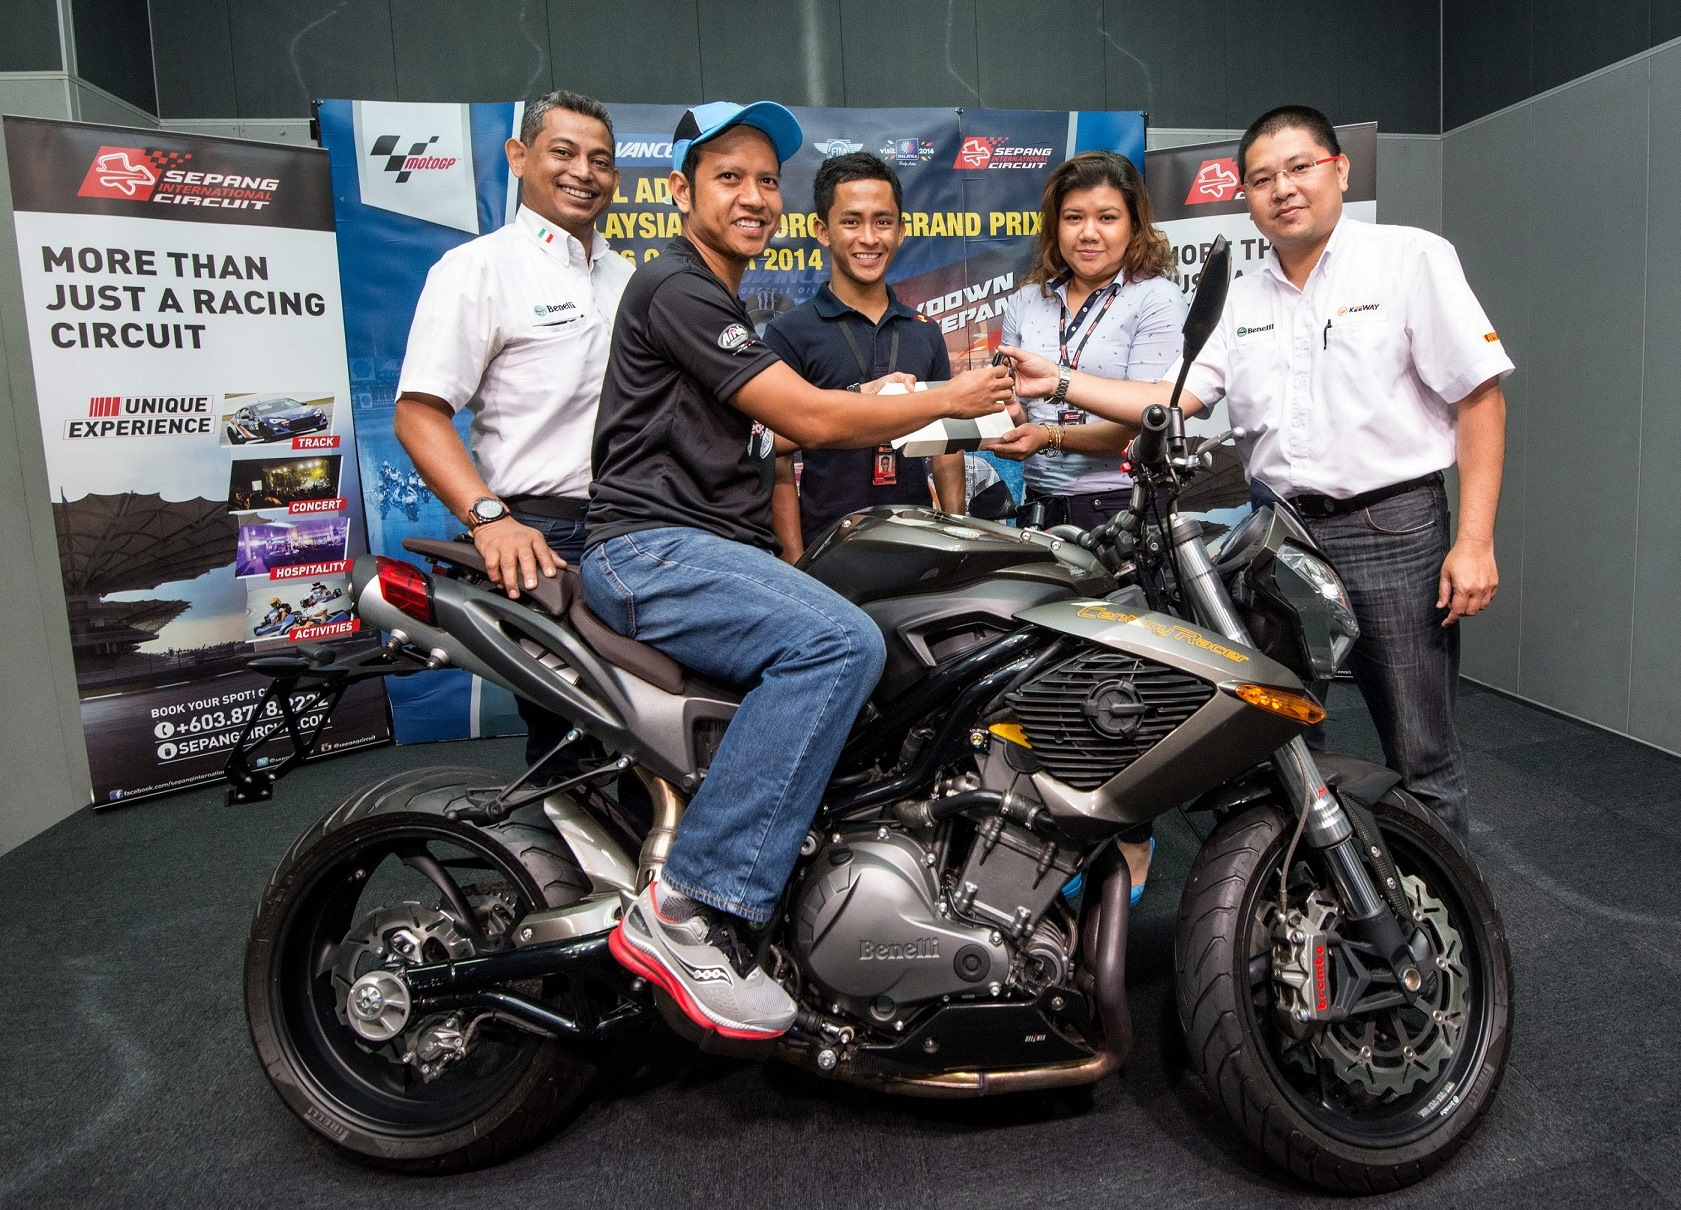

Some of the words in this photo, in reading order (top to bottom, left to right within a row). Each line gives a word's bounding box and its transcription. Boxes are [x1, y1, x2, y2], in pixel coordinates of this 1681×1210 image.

[993, 147, 1053, 156] SEPANG
[163, 170, 280, 191] SEPANG
[158, 183, 272, 200] INTERNATIONAL
[153, 193, 270, 210] CIRCUIT
[901, 212, 982, 236] GRAND
[989, 212, 1045, 236] PRIX
[41, 245, 158, 276] MORE
[167, 252, 269, 280] THAN
[763, 248, 823, 271] 2014
[45, 285, 146, 313] JUST
[158, 288, 184, 313] A
[193, 289, 326, 316] RACING
[546, 301, 577, 313] Benelli
[50, 322, 206, 349] CIRCUIT
[1247, 323, 1275, 334] Benelli
[125, 397, 208, 414] UNIQUE
[68, 418, 211, 438] EXPERIENCE
[297, 437, 334, 448] TRACK
[291, 499, 343, 513] CONCERT
[276, 561, 347, 578] HOSPITALITY
[294, 622, 353, 640] ACTIVITIES
[151, 702, 186, 719] BOOK
[187, 698, 220, 712] YOUR
[222, 689, 256, 704] SPOT!
[859, 937, 940, 961] Benelli
[1314, 945, 1328, 1010] brembo
